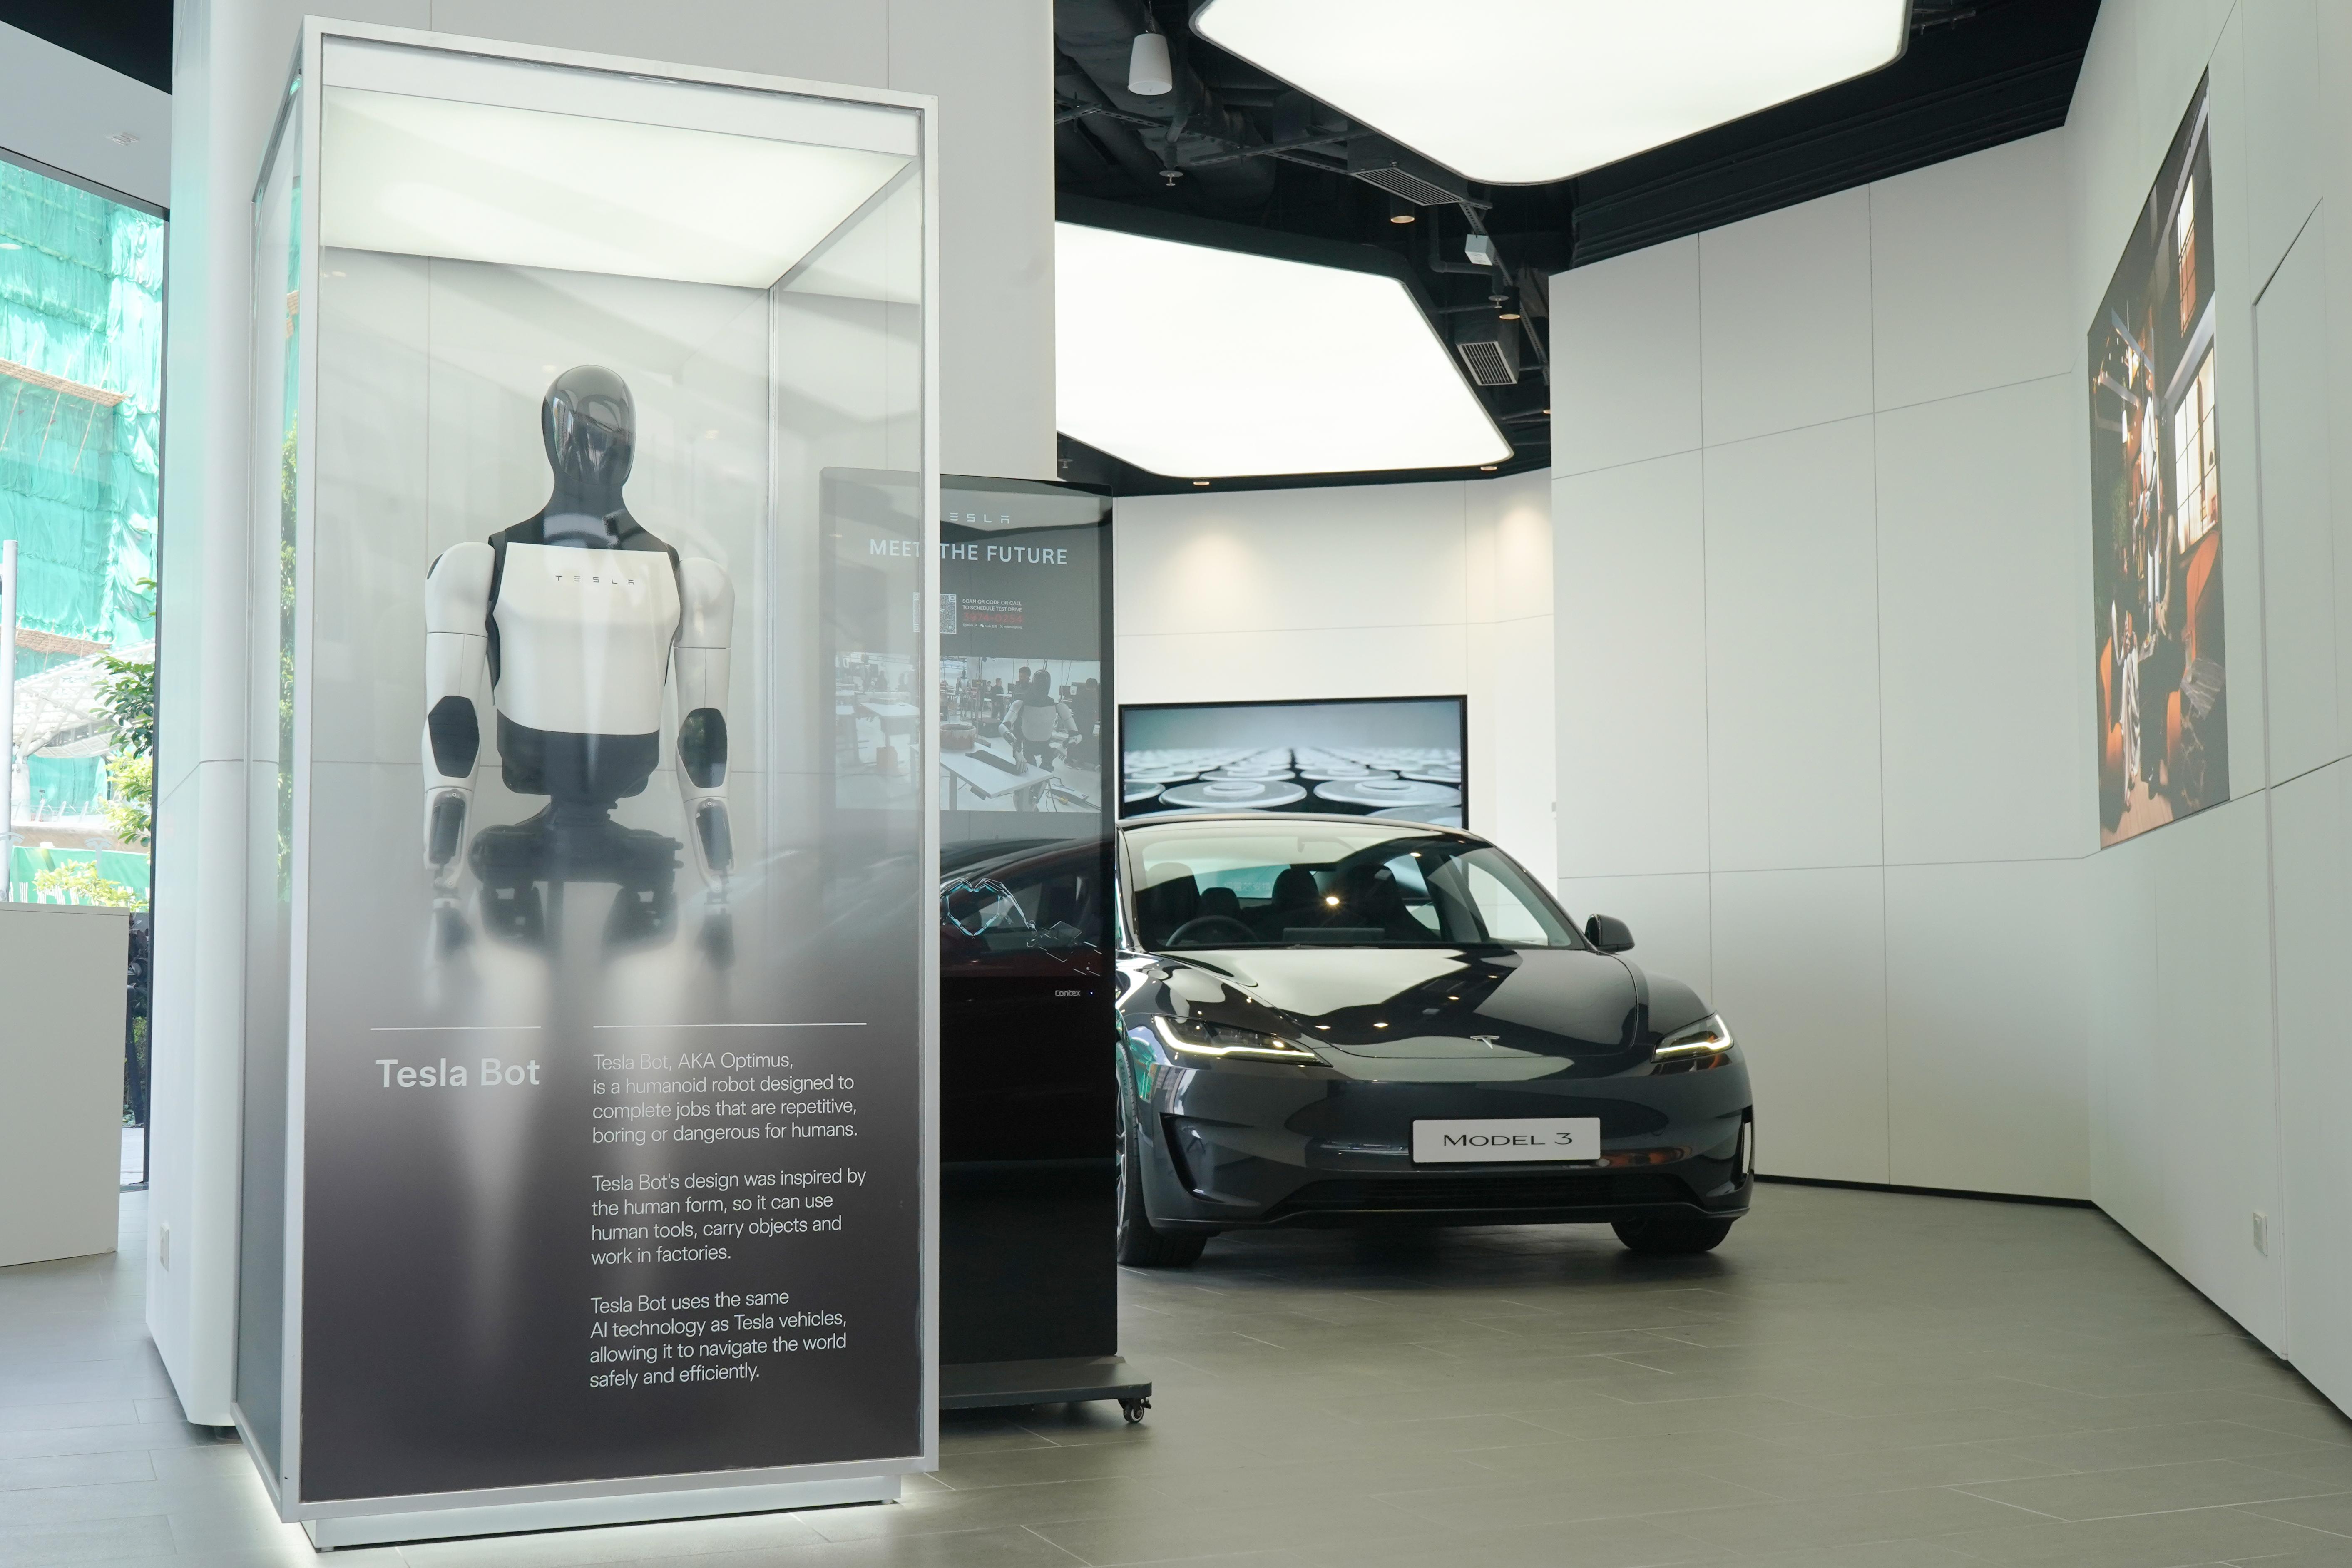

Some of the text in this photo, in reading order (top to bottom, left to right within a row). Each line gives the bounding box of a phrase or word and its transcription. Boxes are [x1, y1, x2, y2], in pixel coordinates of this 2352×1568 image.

[950, 512, 1009, 524] ESLA
[940, 543, 978, 560] THE
[987, 545, 1067, 564] FUTURE
[555, 575, 635, 585] TESLA
[594, 1052, 793, 1071] Tesla Bot, AKA Optimus,
[376, 1058, 540, 1087] Tesla Bot
[594, 1074, 854, 1094] is a humanoid robot designed to
[593, 1098, 856, 1121] complete jobs that are repetitive,
[593, 1122, 857, 1146] boring or dangerous for humans.
[1554, 1133, 1573, 1145] 3
[592, 1168, 866, 1191] Tesla Bot's design was inspired by
[592, 1195, 833, 1215] the human form, so it can use
[592, 1215, 841, 1240] human tools, carry objects and
[592, 1245, 731, 1264] work in factories.
[591, 1292, 789, 1313] Tesla Bot uses the same
[591, 1310, 845, 1338] AI technology as Tesla vehicles,
[590, 1333, 846, 1363] allowing it to navigate the world
[590, 1362, 759, 1389] safely and efficiently.
